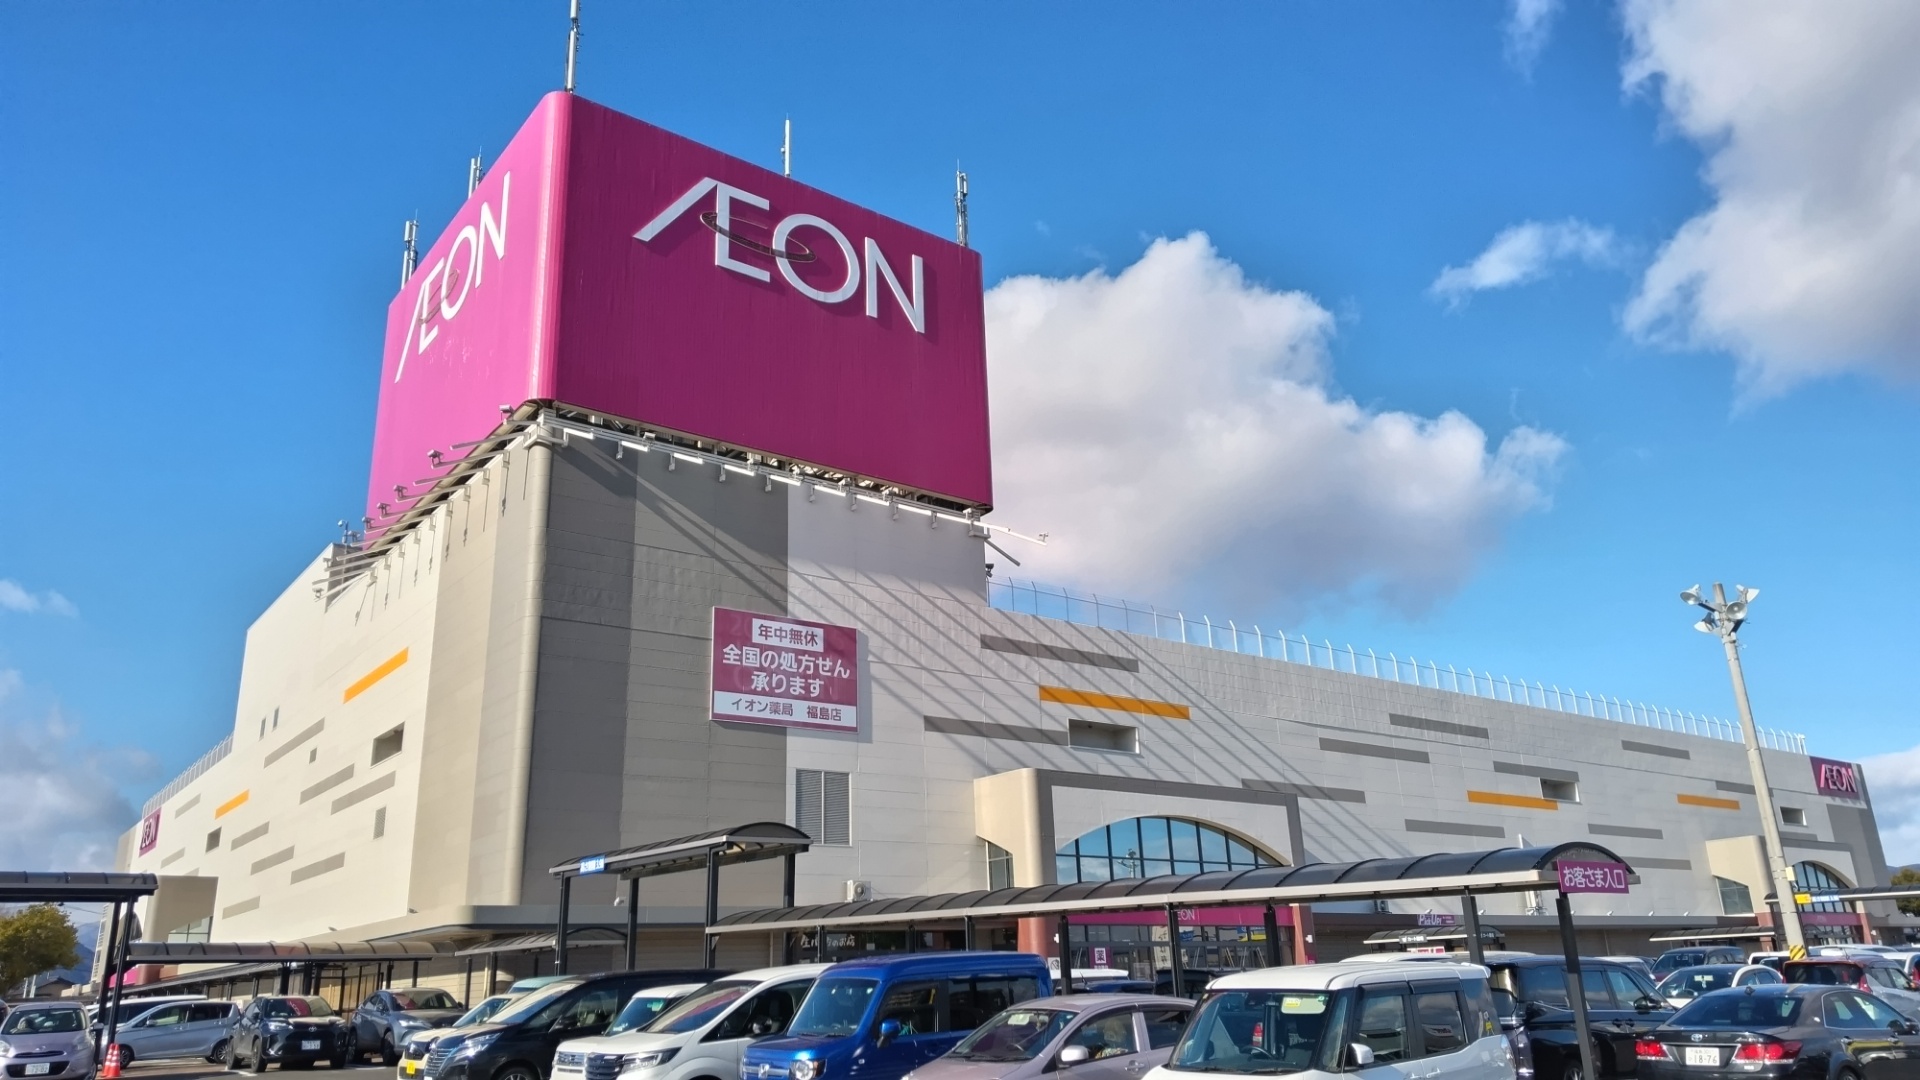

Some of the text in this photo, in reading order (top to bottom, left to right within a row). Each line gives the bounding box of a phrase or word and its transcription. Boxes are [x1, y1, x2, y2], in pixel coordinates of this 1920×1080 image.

[758, 624, 819, 647] 年中無休
[722, 643, 850, 679] 全国の処方せん
[751, 671, 825, 697] 承ります
[731, 698, 842, 722] イオン薬局 福島店
[1563, 866, 1625, 889] お客さま入口
